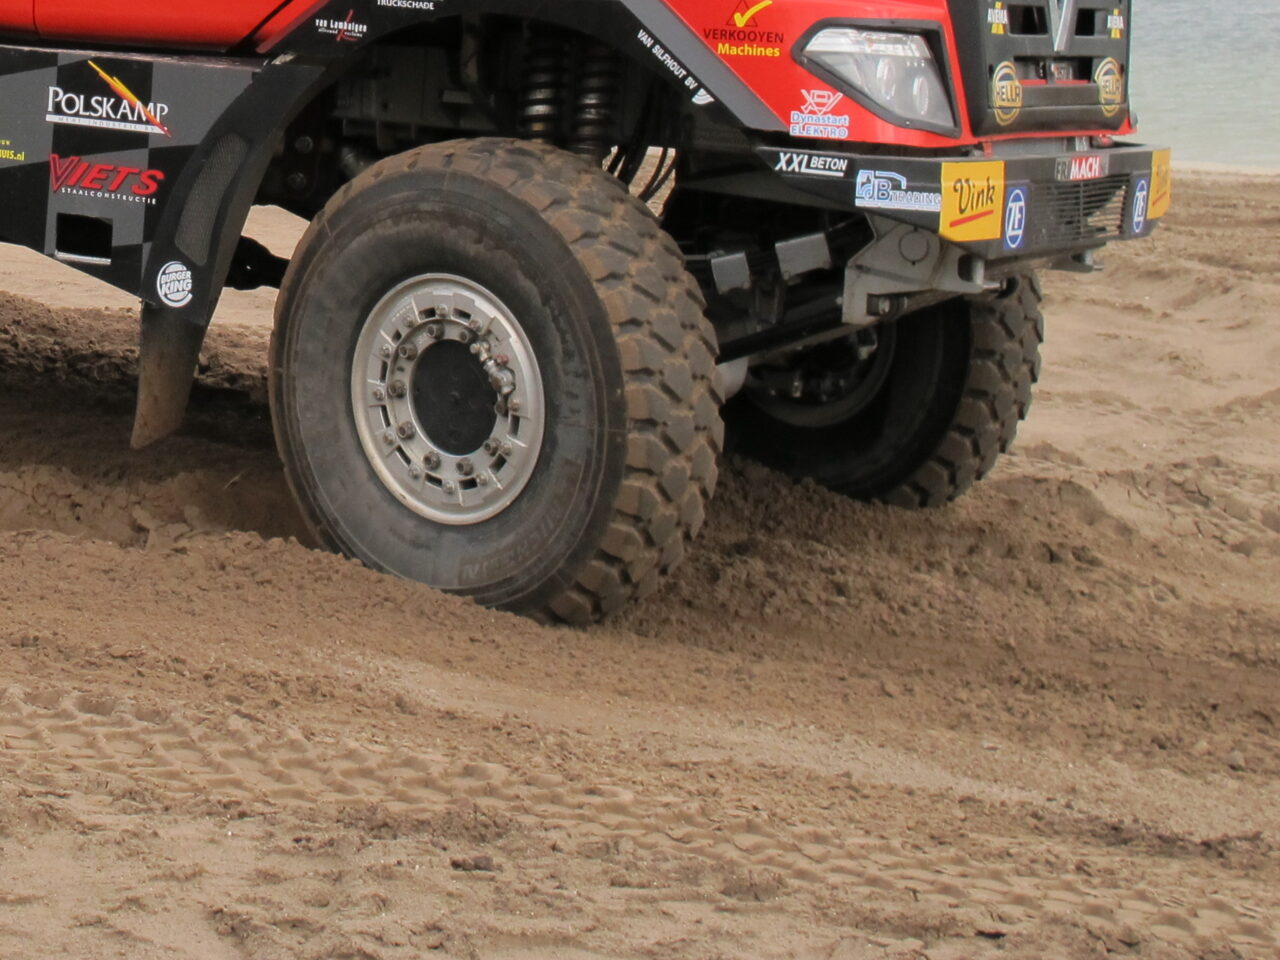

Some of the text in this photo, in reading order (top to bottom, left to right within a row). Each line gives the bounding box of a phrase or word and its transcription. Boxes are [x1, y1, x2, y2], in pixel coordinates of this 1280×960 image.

[703, 28, 784, 43] VERKOOYEN
[717, 43, 781, 57] Machines
[637, 28, 698, 90] VAN SILFHOUT BV
[47, 86, 169, 122] POLSKAMP
[791, 111, 849, 126] Dynastart
[790, 124, 848, 138] ELEKTRO
[810, 156, 848, 171] BETON
[49, 154, 165, 195] VIETS
[62, 187, 157, 205] STAALCONSTRUCTIE
[953, 176, 995, 215] Vink
[161, 271, 192, 284] BURGER
[161, 280, 192, 296] KING
